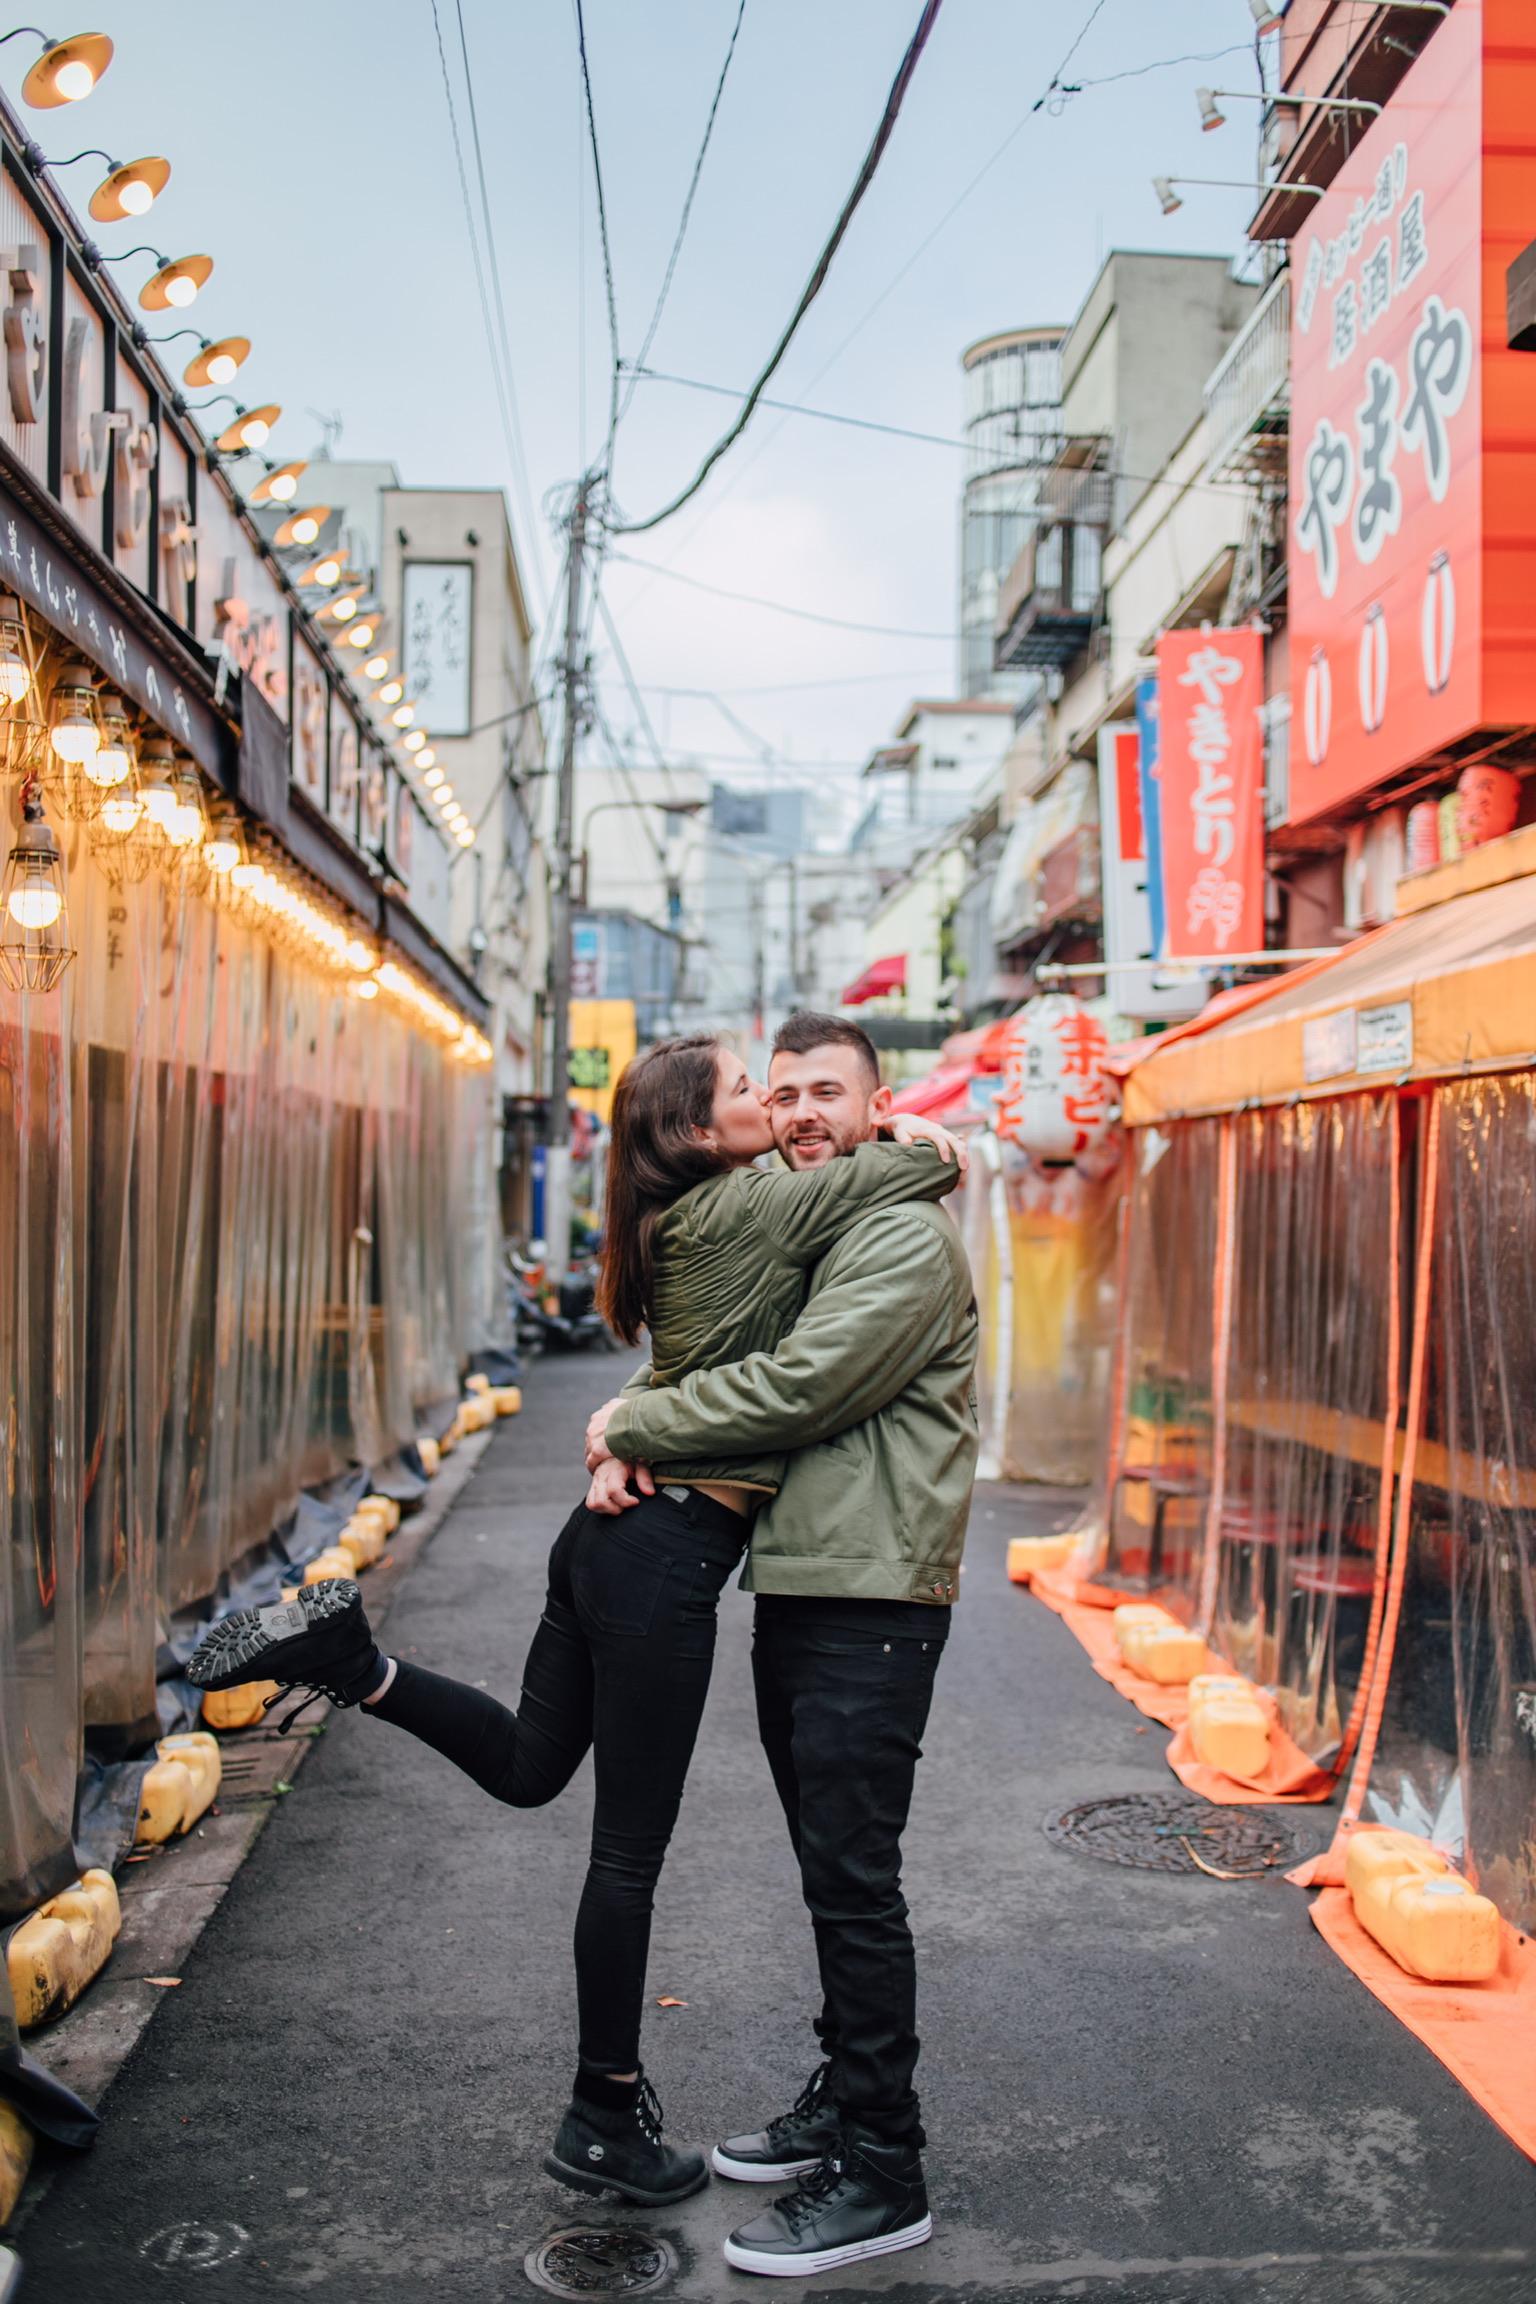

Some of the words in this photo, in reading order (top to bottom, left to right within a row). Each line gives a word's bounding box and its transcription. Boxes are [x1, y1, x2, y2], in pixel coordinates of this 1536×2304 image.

[1297, 300, 1469, 592] やまや
[1177, 646, 1245, 868] やきとり
